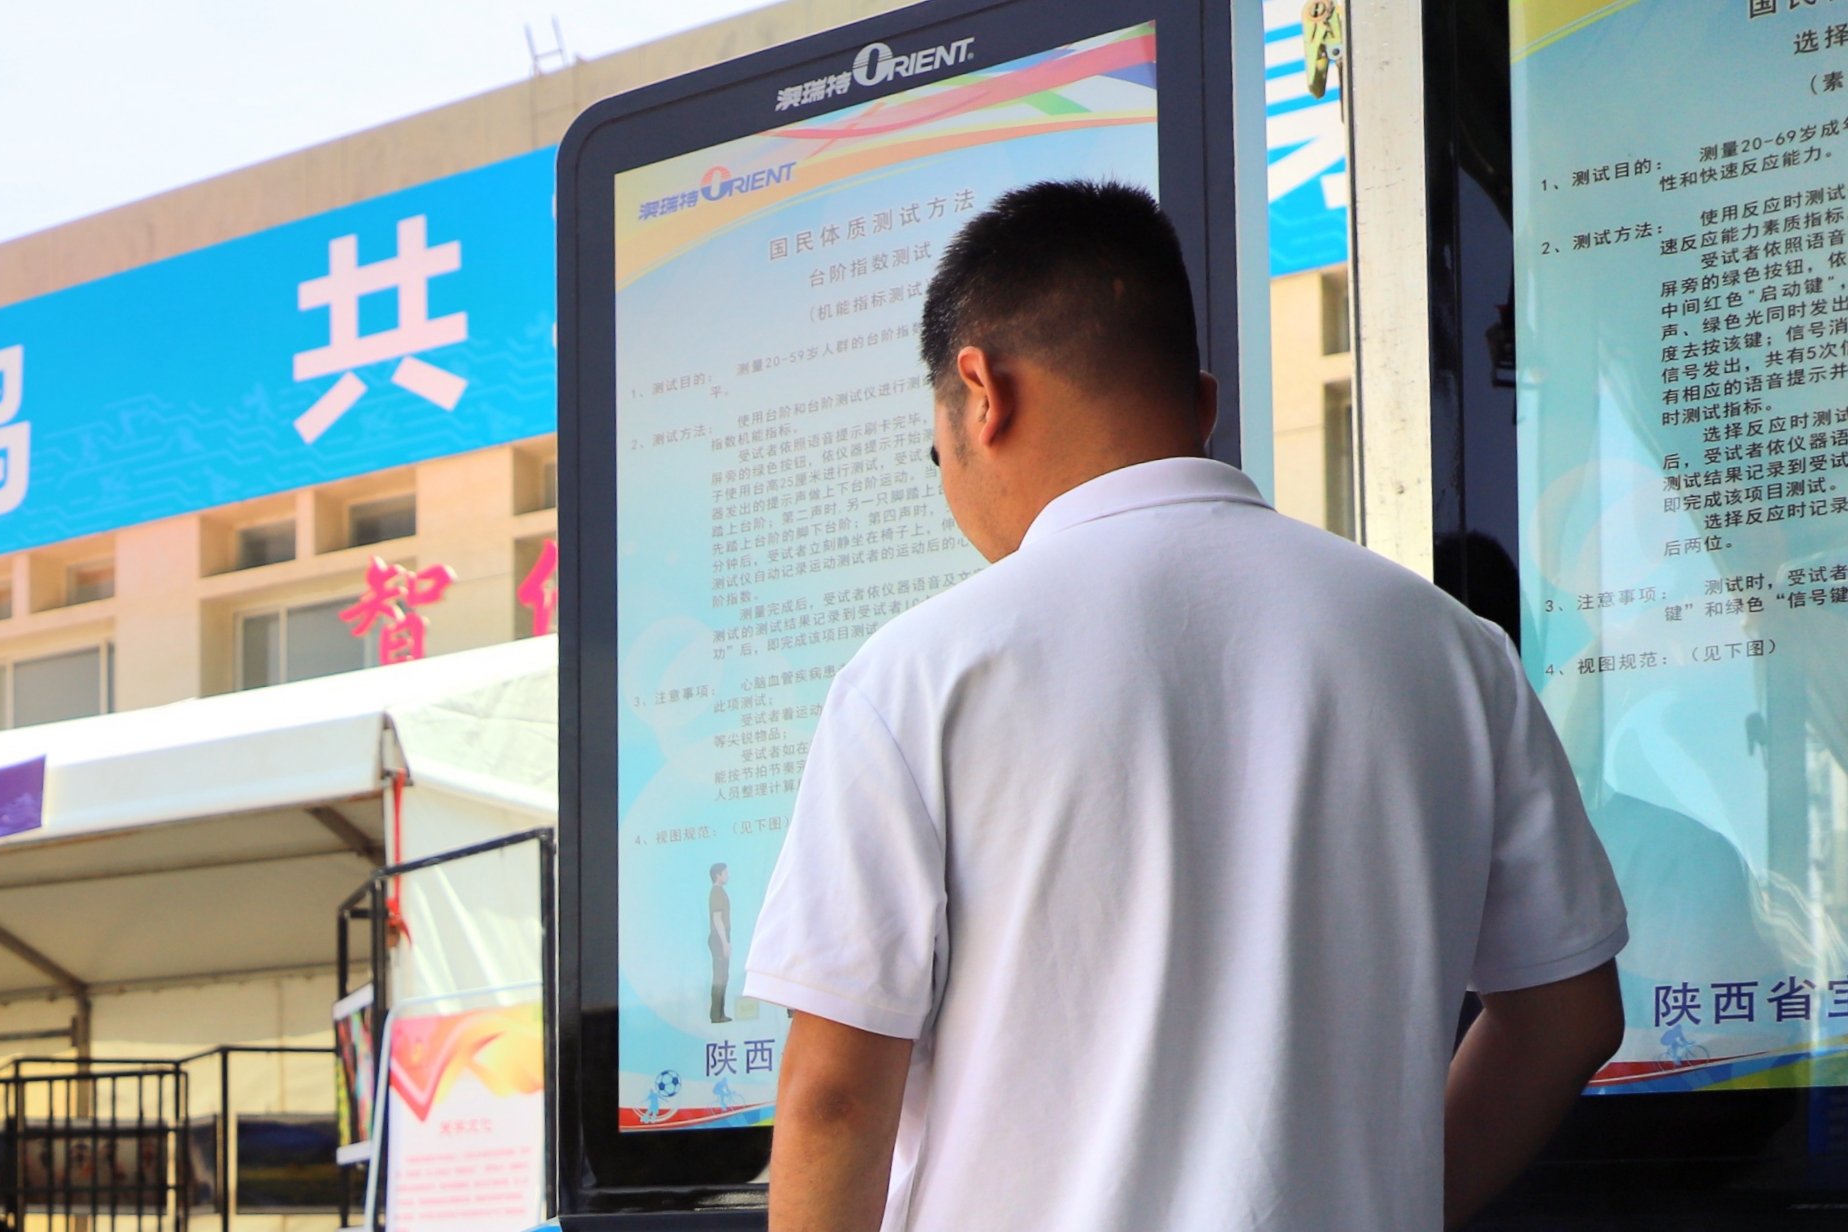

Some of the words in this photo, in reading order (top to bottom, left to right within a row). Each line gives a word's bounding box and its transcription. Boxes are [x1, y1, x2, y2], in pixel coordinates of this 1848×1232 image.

[1793, 22, 1848, 55] 选择
[853, 37, 975, 87] ORIENT
[700, 160, 797, 201] ORIENT
[768, 187, 976, 262] 国民体质测试方法
[808, 240, 932, 288] 台阶指数测试
[1700, 228, 1846, 271] 受试者依照语音
[291, 214, 470, 446] 共
[1661, 361, 1848, 406] 有相应的语音提示并
[1661, 397, 1773, 427] 时测试指标。
[1703, 405, 1848, 444] 选择反应时测试
[1662, 450, 1848, 493] 测试结果记录到受试
[1663, 475, 1836, 514] 即完成该项目测试。
[1703, 495, 1848, 530] 选择反应时记录
[1663, 534, 1734, 558] 后两位。
[740, 663, 846, 692] 心脑血管疾病患
[714, 777, 804, 802] 人员整理计算
[705, 1039, 776, 1078] 陕西
